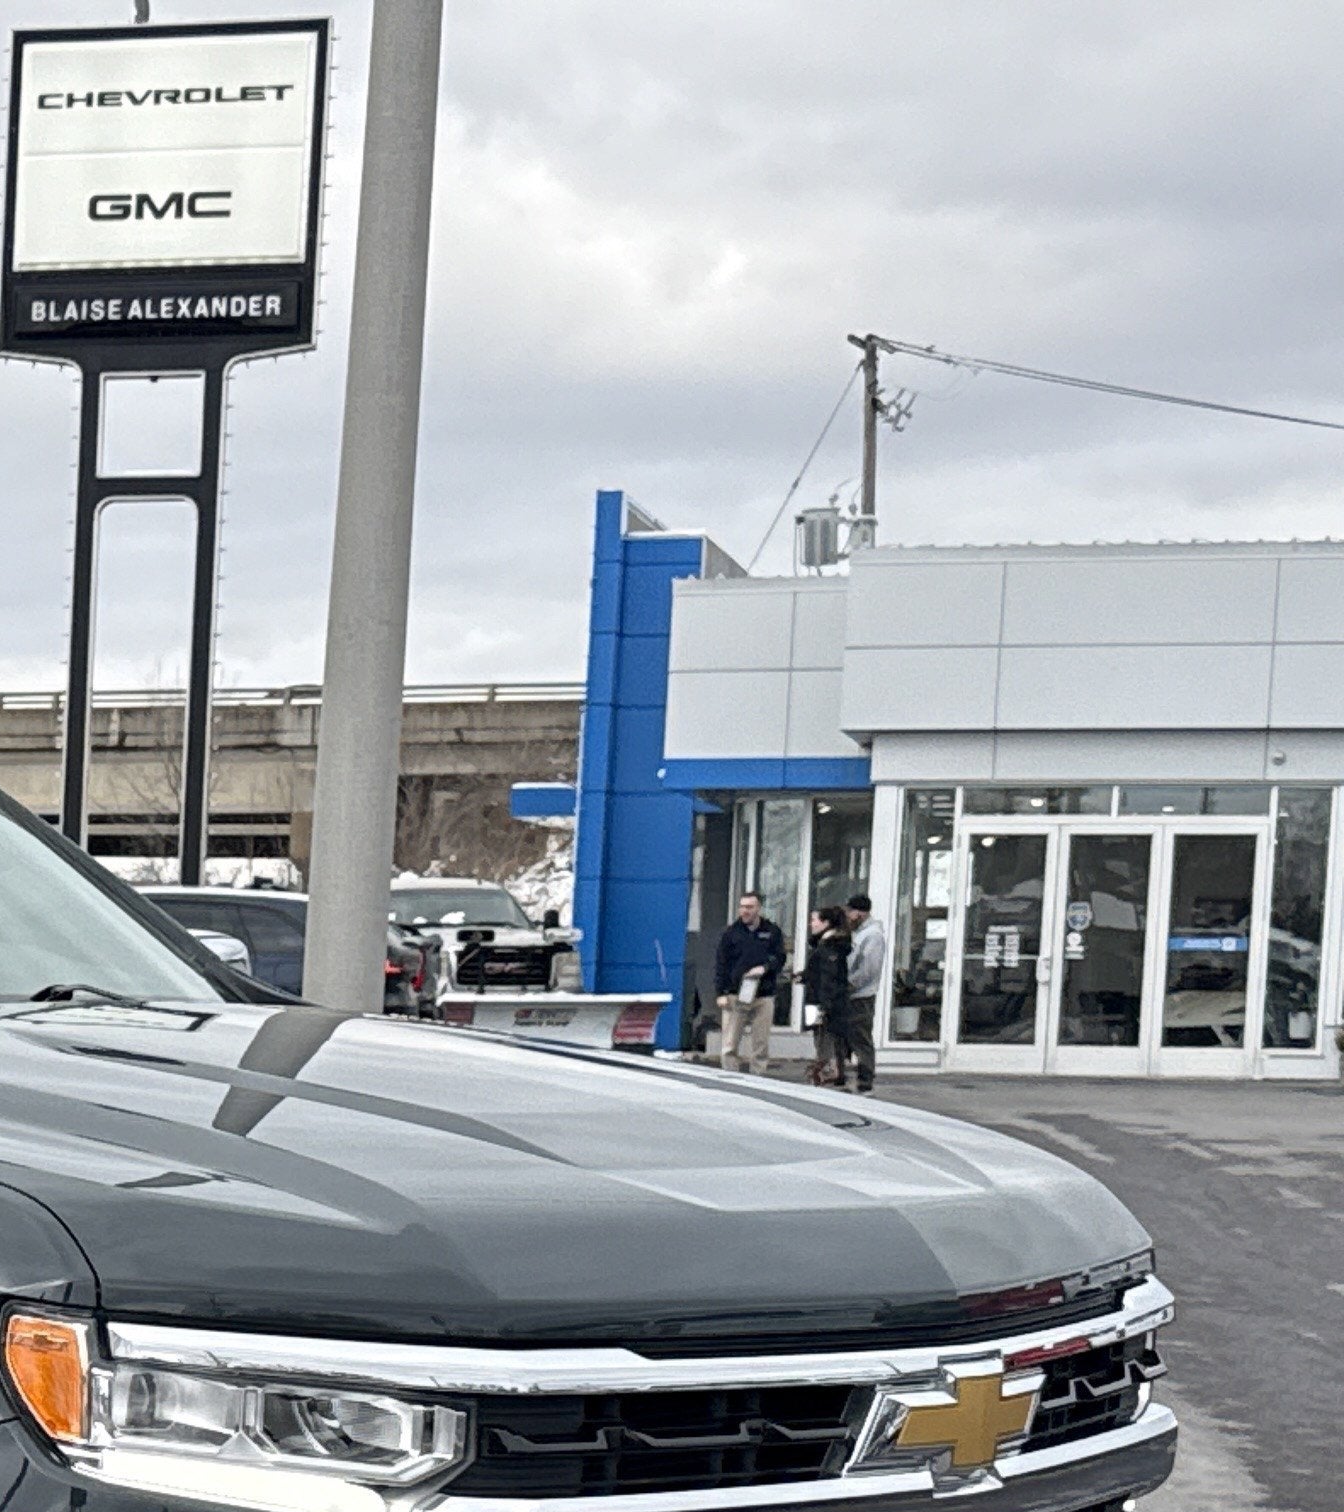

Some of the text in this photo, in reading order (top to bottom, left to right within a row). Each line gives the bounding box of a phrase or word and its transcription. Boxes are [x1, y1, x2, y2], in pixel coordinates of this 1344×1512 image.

[37, 84, 294, 110] CHEVROLET
[88, 191, 232, 221] GMC
[31, 294, 282, 322] BLAISE ALEXANDER
